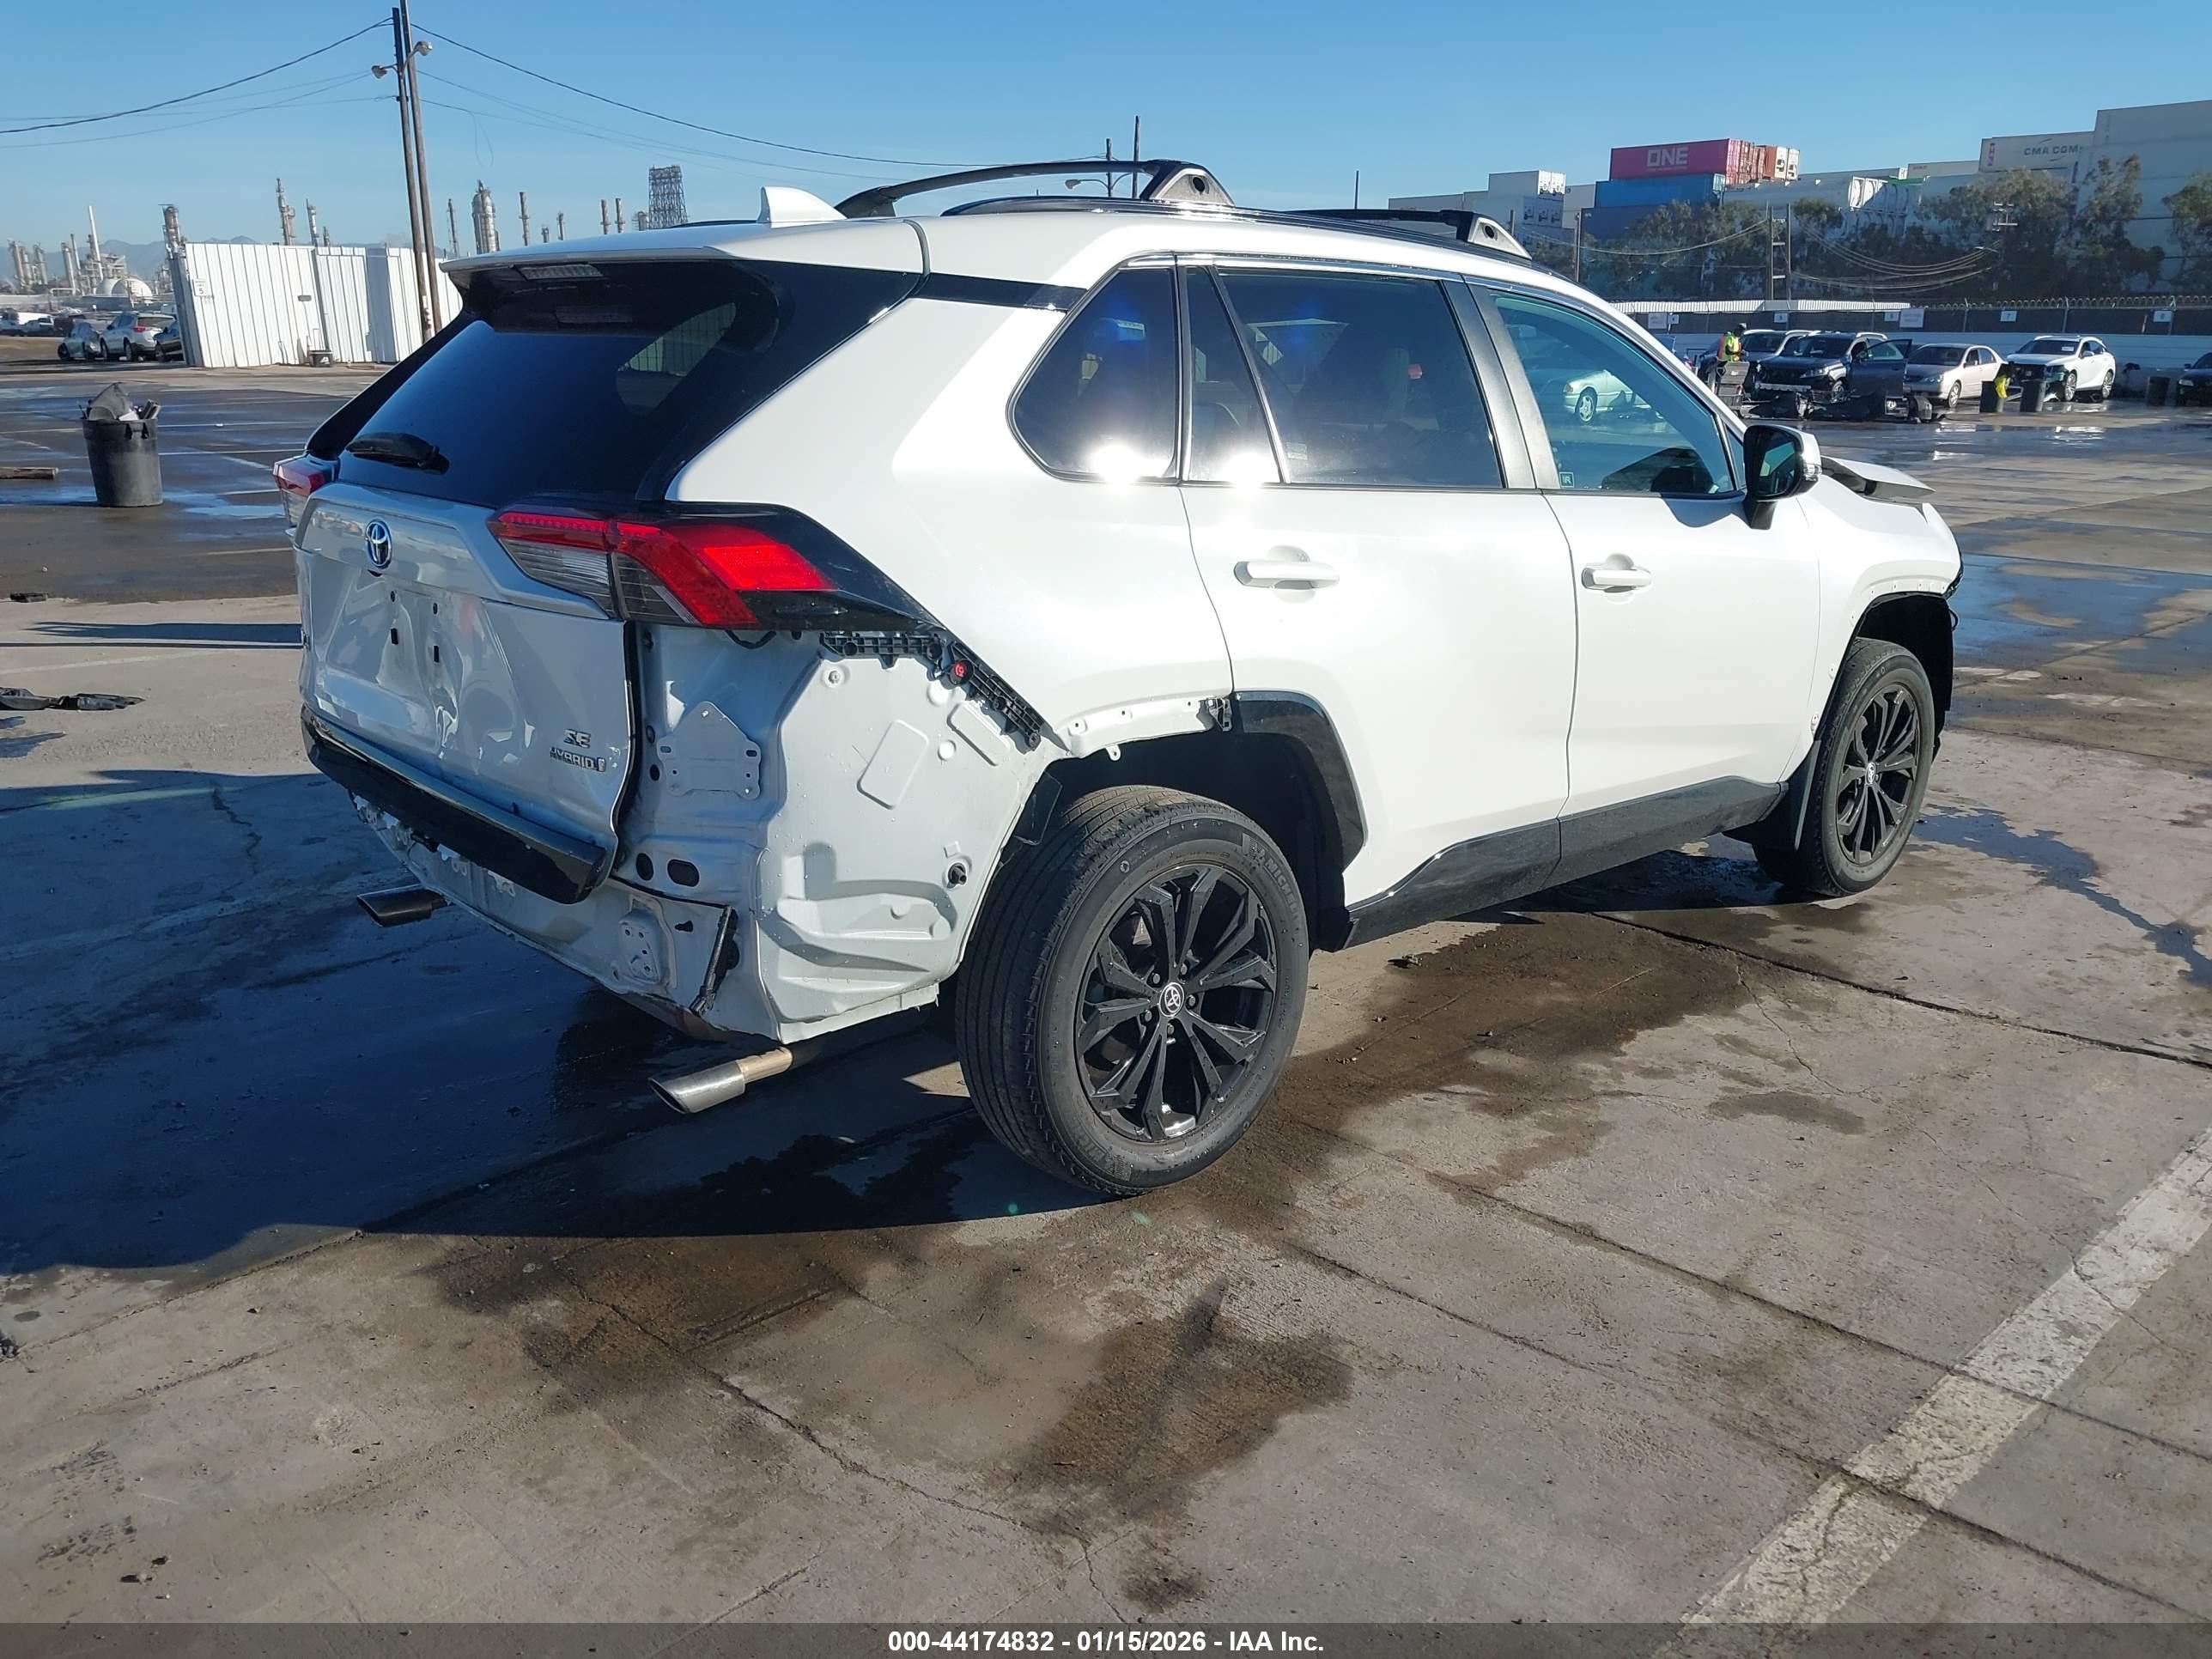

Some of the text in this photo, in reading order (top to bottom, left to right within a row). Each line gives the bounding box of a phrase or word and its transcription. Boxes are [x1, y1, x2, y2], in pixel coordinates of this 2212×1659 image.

[1647, 146, 1689, 167] ONE
[2023, 144, 2079, 156] CMA CGM
[563, 728, 591, 749] SE
[550, 747, 597, 770] HYBRID
